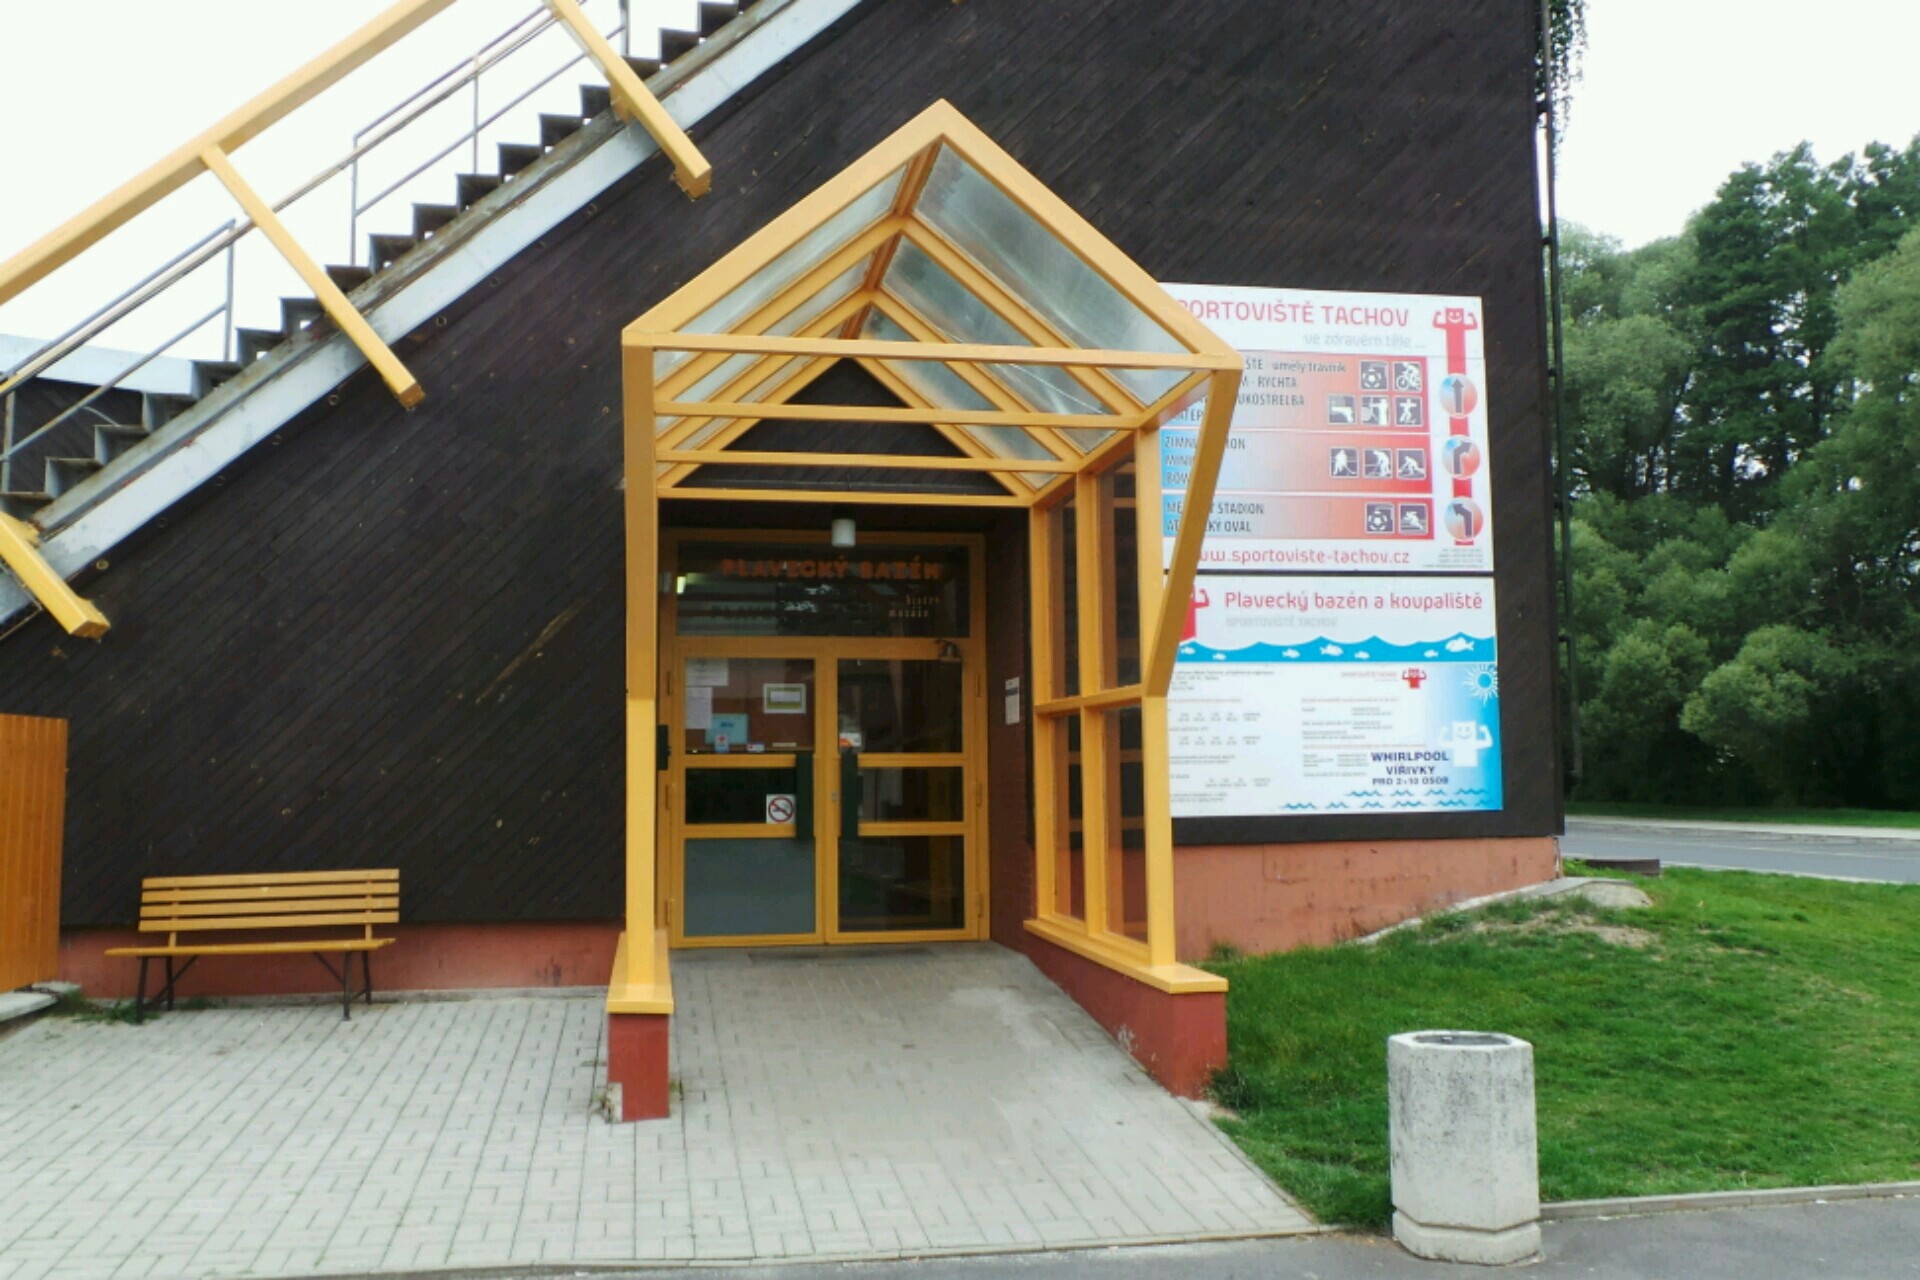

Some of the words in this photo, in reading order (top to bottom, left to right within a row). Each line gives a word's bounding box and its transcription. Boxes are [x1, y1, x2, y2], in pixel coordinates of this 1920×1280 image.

[1320, 305, 1410, 327] TACHOV
[1257, 376, 1297, 388] RYCHTA
[721, 555, 848, 578] PLAVECKÝ
[860, 555, 942, 579] BAZÉN
[1225, 591, 1309, 612] Plavecký
[1314, 592, 1368, 609] bazén
[1374, 596, 1384, 609] a
[1390, 592, 1483, 612] koupaliště
[1371, 750, 1450, 762] WHIRLPOOL
[1372, 777, 1394, 786] PRO
